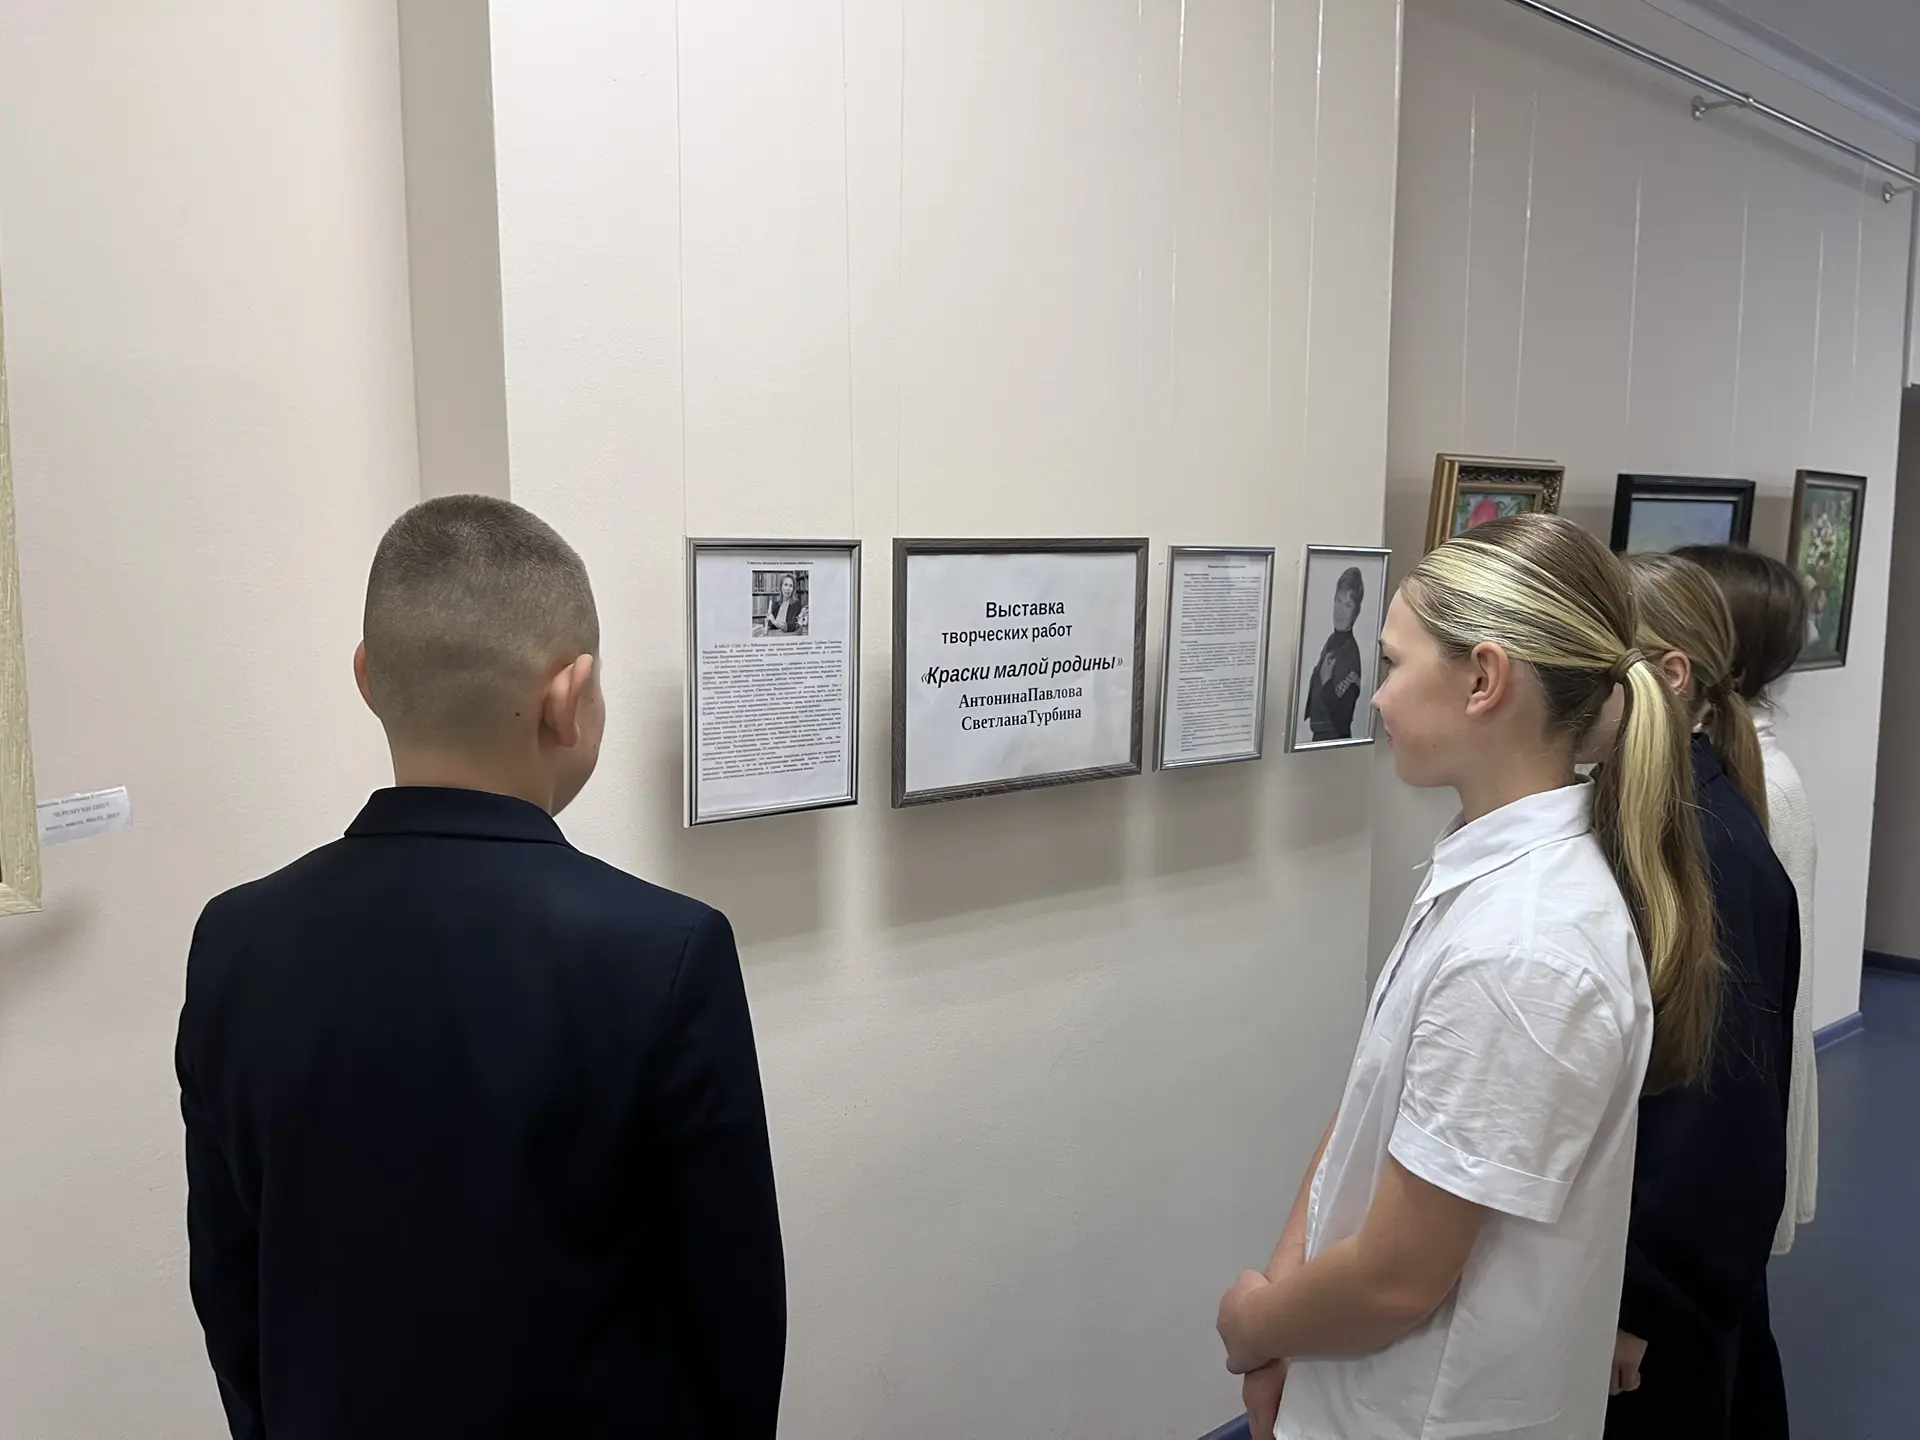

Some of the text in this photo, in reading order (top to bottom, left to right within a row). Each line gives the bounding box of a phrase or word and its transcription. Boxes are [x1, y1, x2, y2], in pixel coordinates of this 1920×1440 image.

[985, 601, 1066, 619] Выставка
[941, 622, 1073, 647] творческих работ
[920, 654, 1125, 689] «Краски малой родины»
